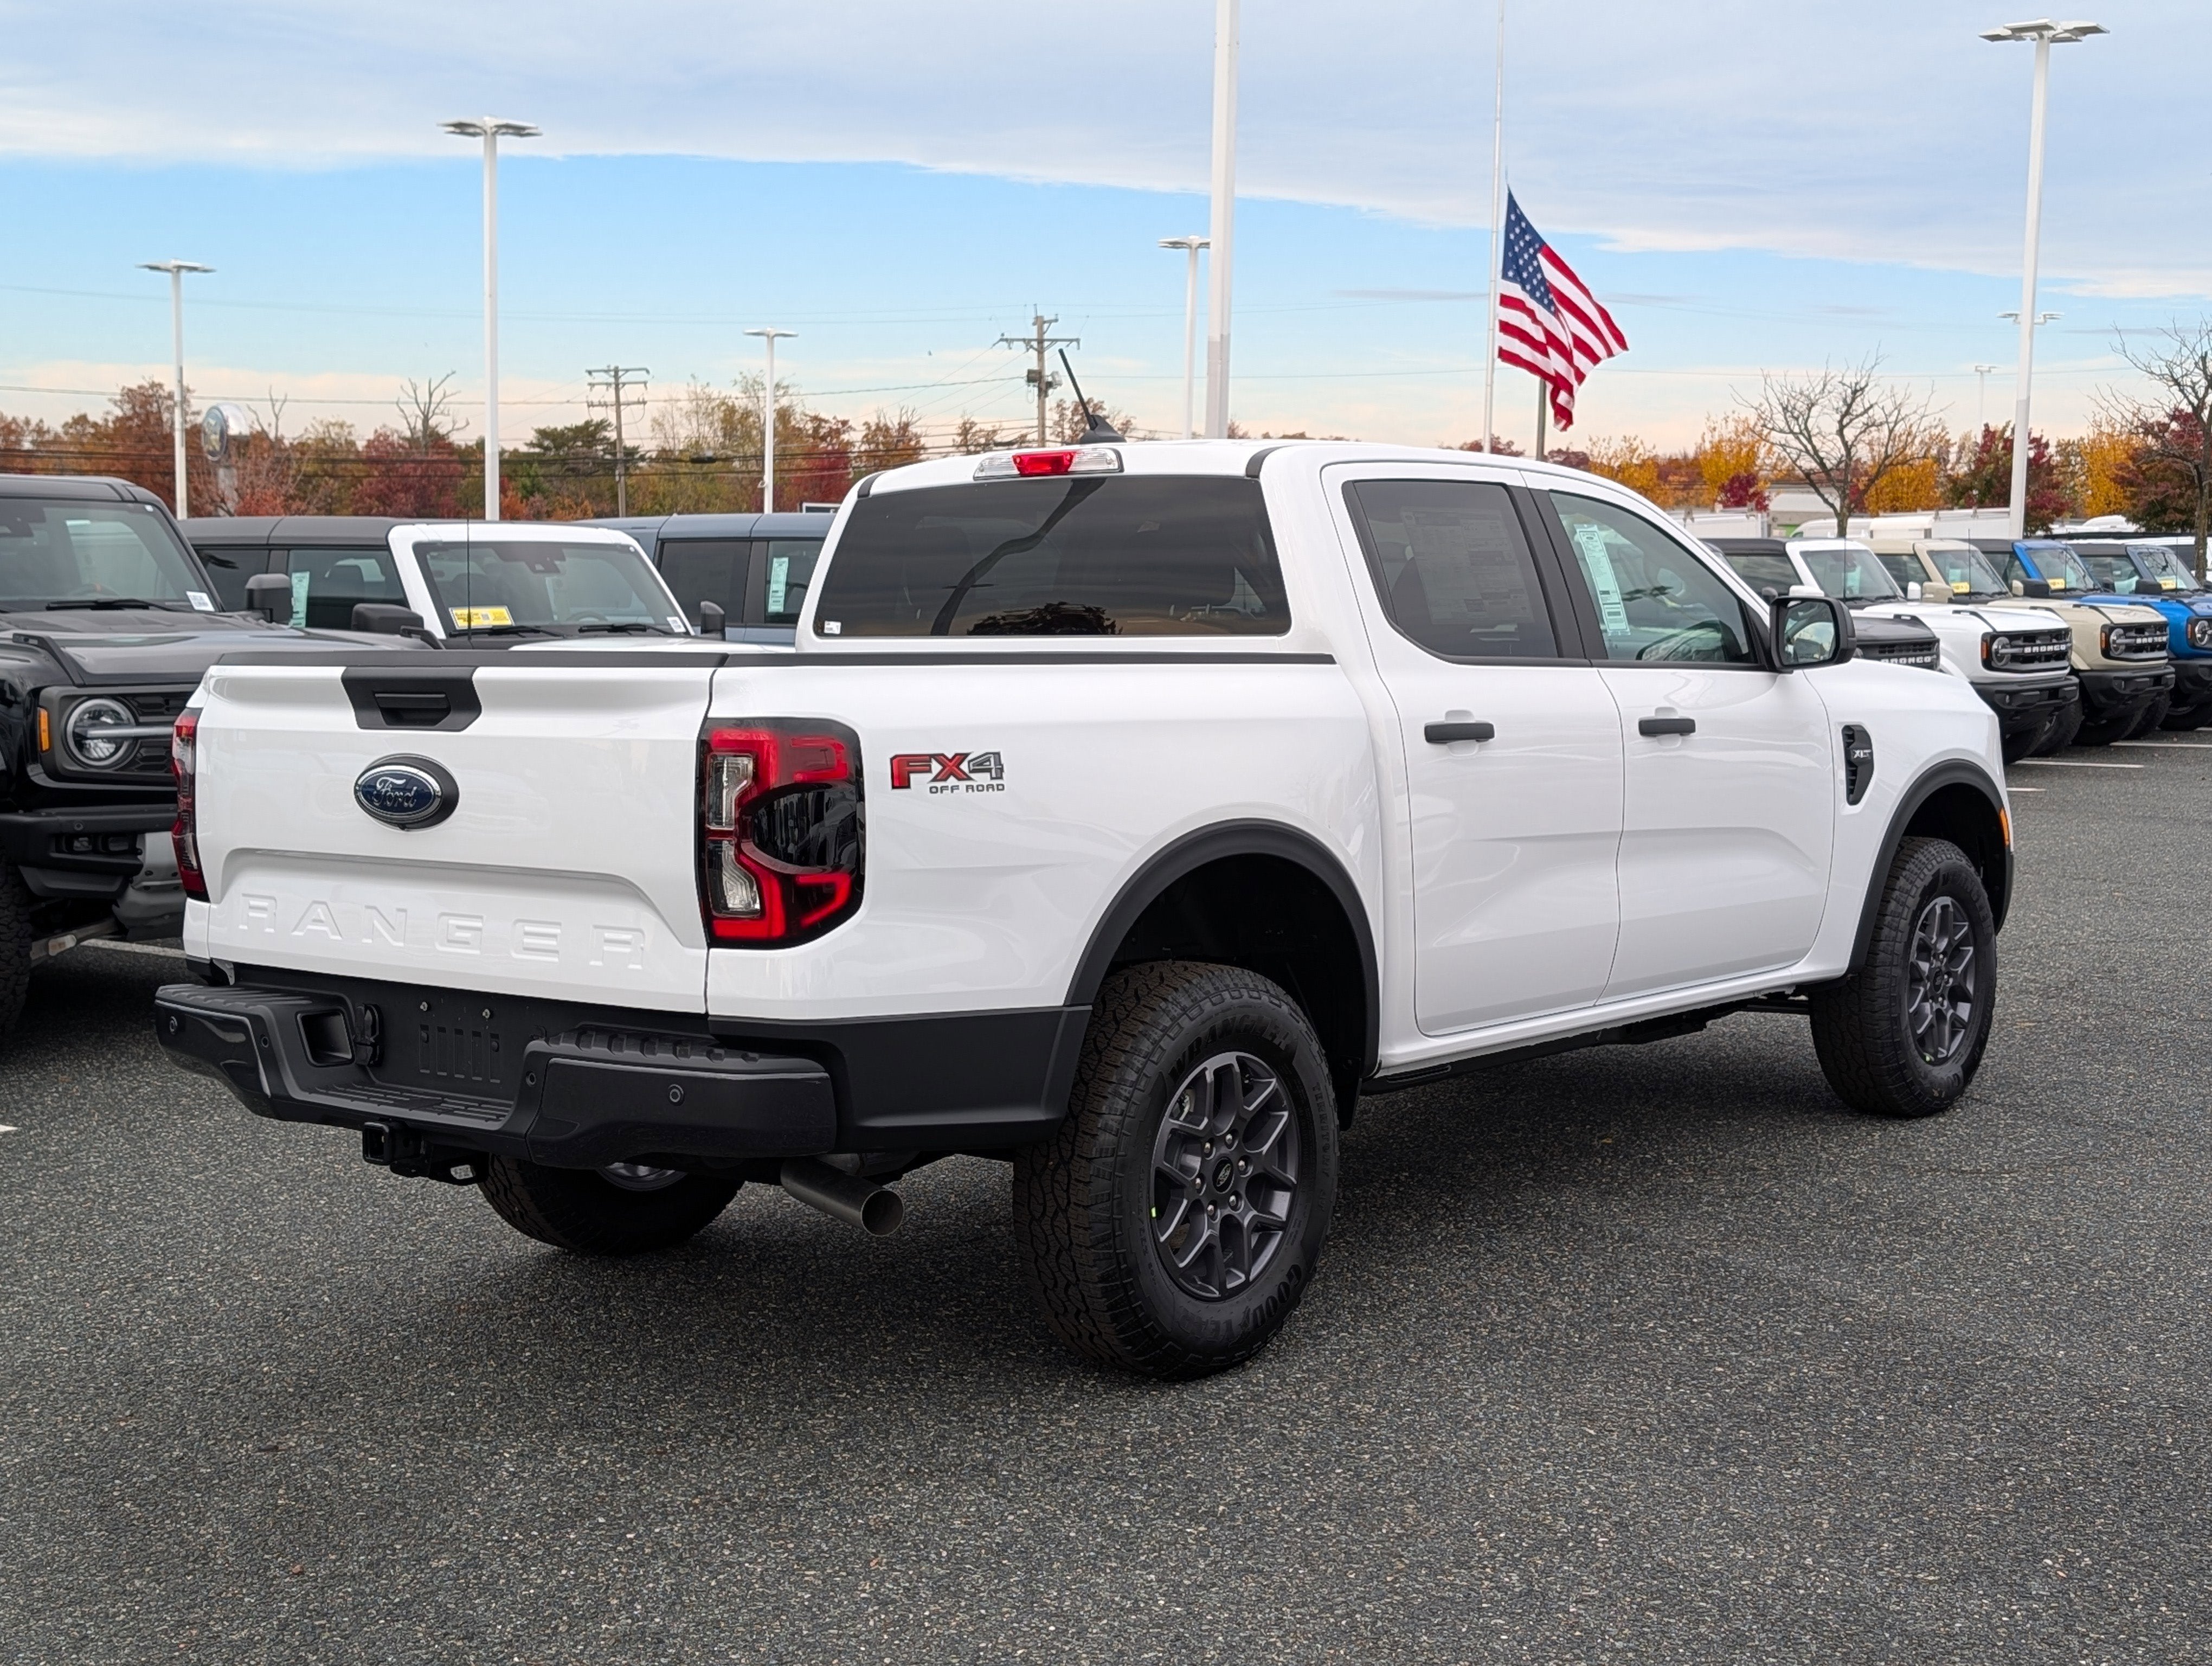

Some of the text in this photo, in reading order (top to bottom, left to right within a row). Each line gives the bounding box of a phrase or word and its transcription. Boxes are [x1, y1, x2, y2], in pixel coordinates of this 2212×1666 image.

[2024, 644, 2066, 653] BRONCO
[890, 751, 1005, 790] FX4
[1853, 749, 1872, 759] XLT
[372, 776, 417, 808] Ford
[929, 784, 1005, 794] OFF ROAD
[239, 893, 645, 970] RANGER
[1168, 1013, 1293, 1083] WRANGLER
[1175, 1263, 1303, 1347] GOODYEAR
